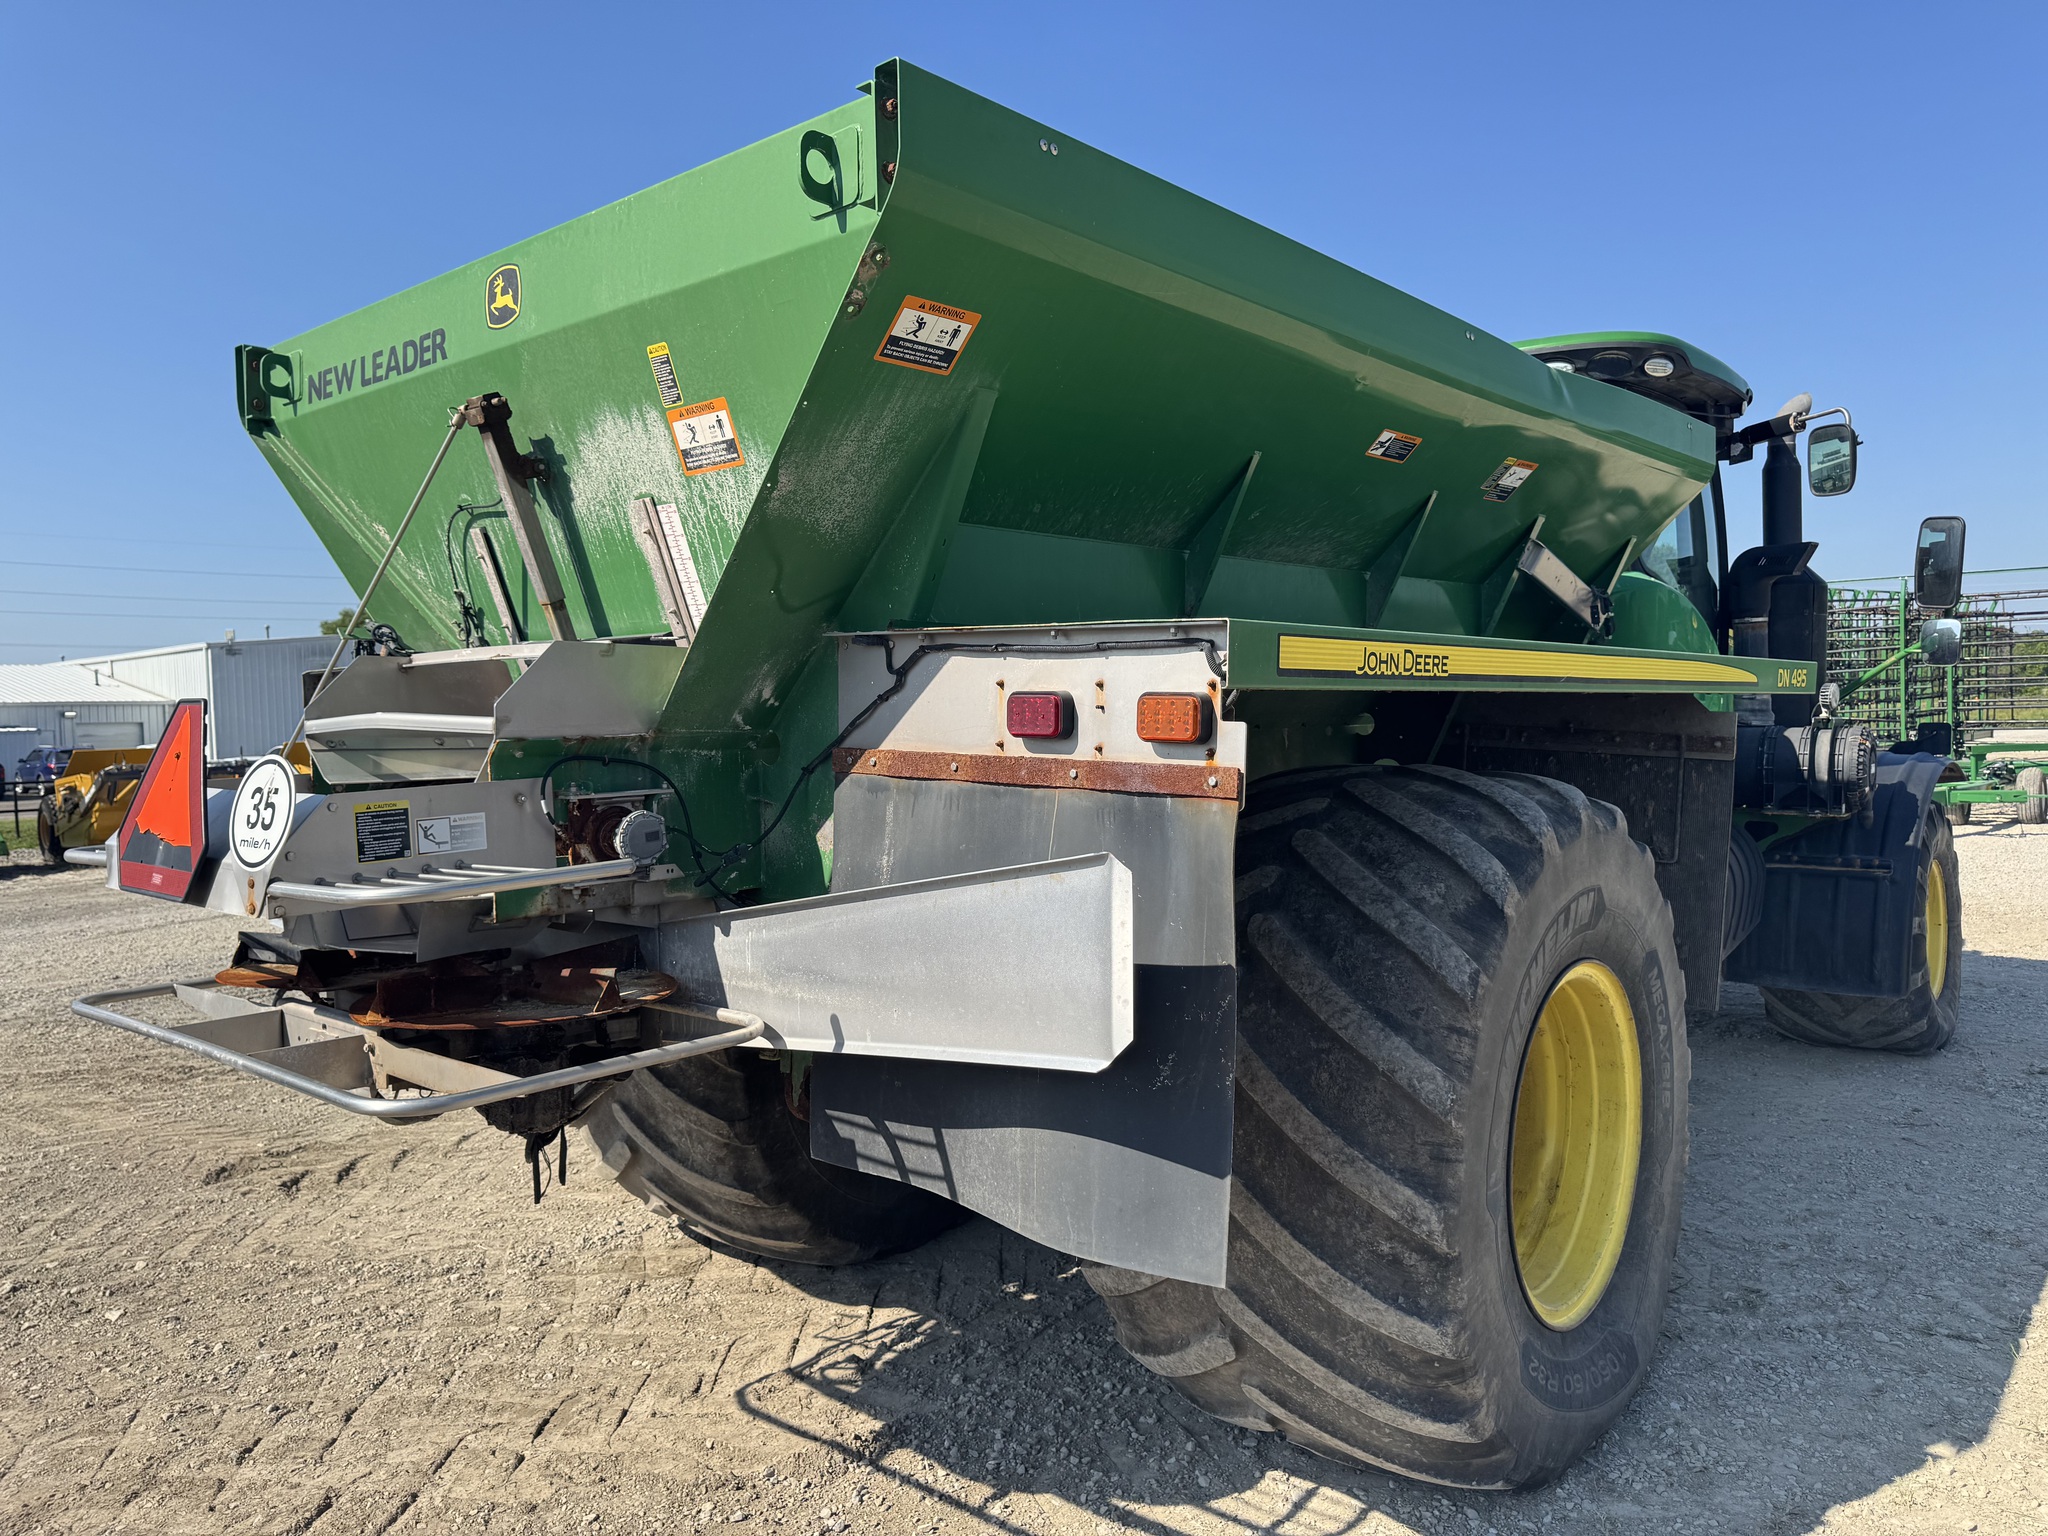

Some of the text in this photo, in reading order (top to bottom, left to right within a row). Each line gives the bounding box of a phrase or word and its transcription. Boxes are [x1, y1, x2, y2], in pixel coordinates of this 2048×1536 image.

[929, 303, 966, 320] WARNING
[308, 328, 447, 404] NEW LEADER
[685, 402, 715, 416] WARNING
[1777, 668, 1807, 688] DN 495
[246, 787, 279, 831] 35
[240, 838, 271, 850] mile/h
